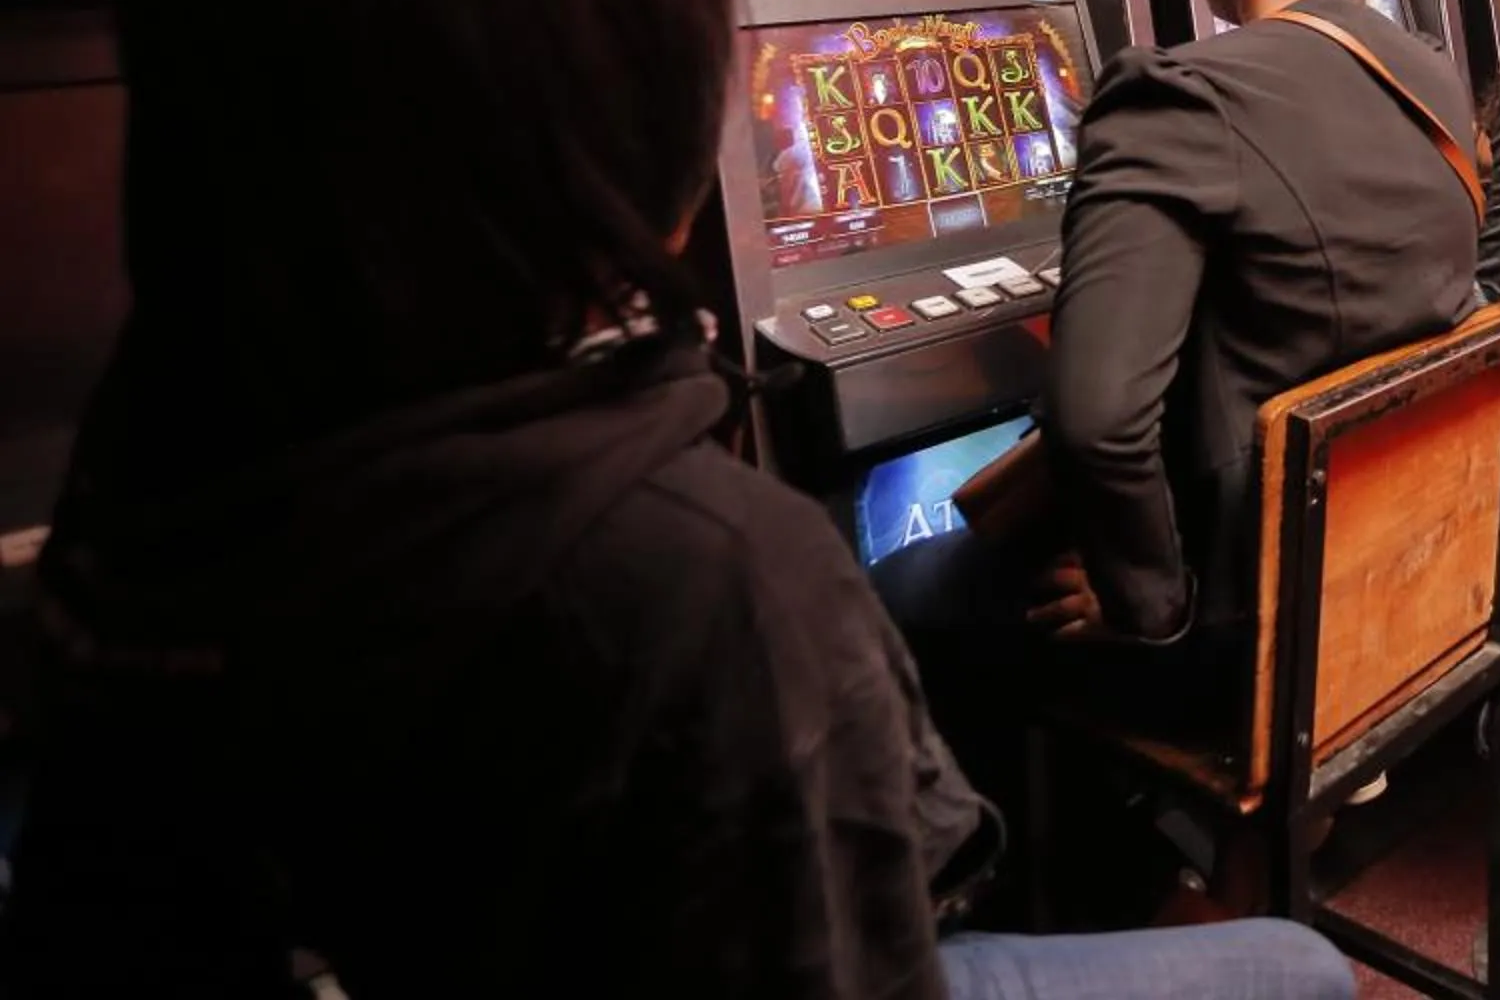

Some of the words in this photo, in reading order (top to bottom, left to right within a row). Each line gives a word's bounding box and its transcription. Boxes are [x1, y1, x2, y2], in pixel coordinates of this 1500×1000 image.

[807, 66, 851, 110] K
[953, 53, 991, 90] Q
[870, 108, 913, 149] Q
[962, 96, 1001, 138] K
[1004, 91, 1043, 132] K
[927, 147, 969, 195] K
